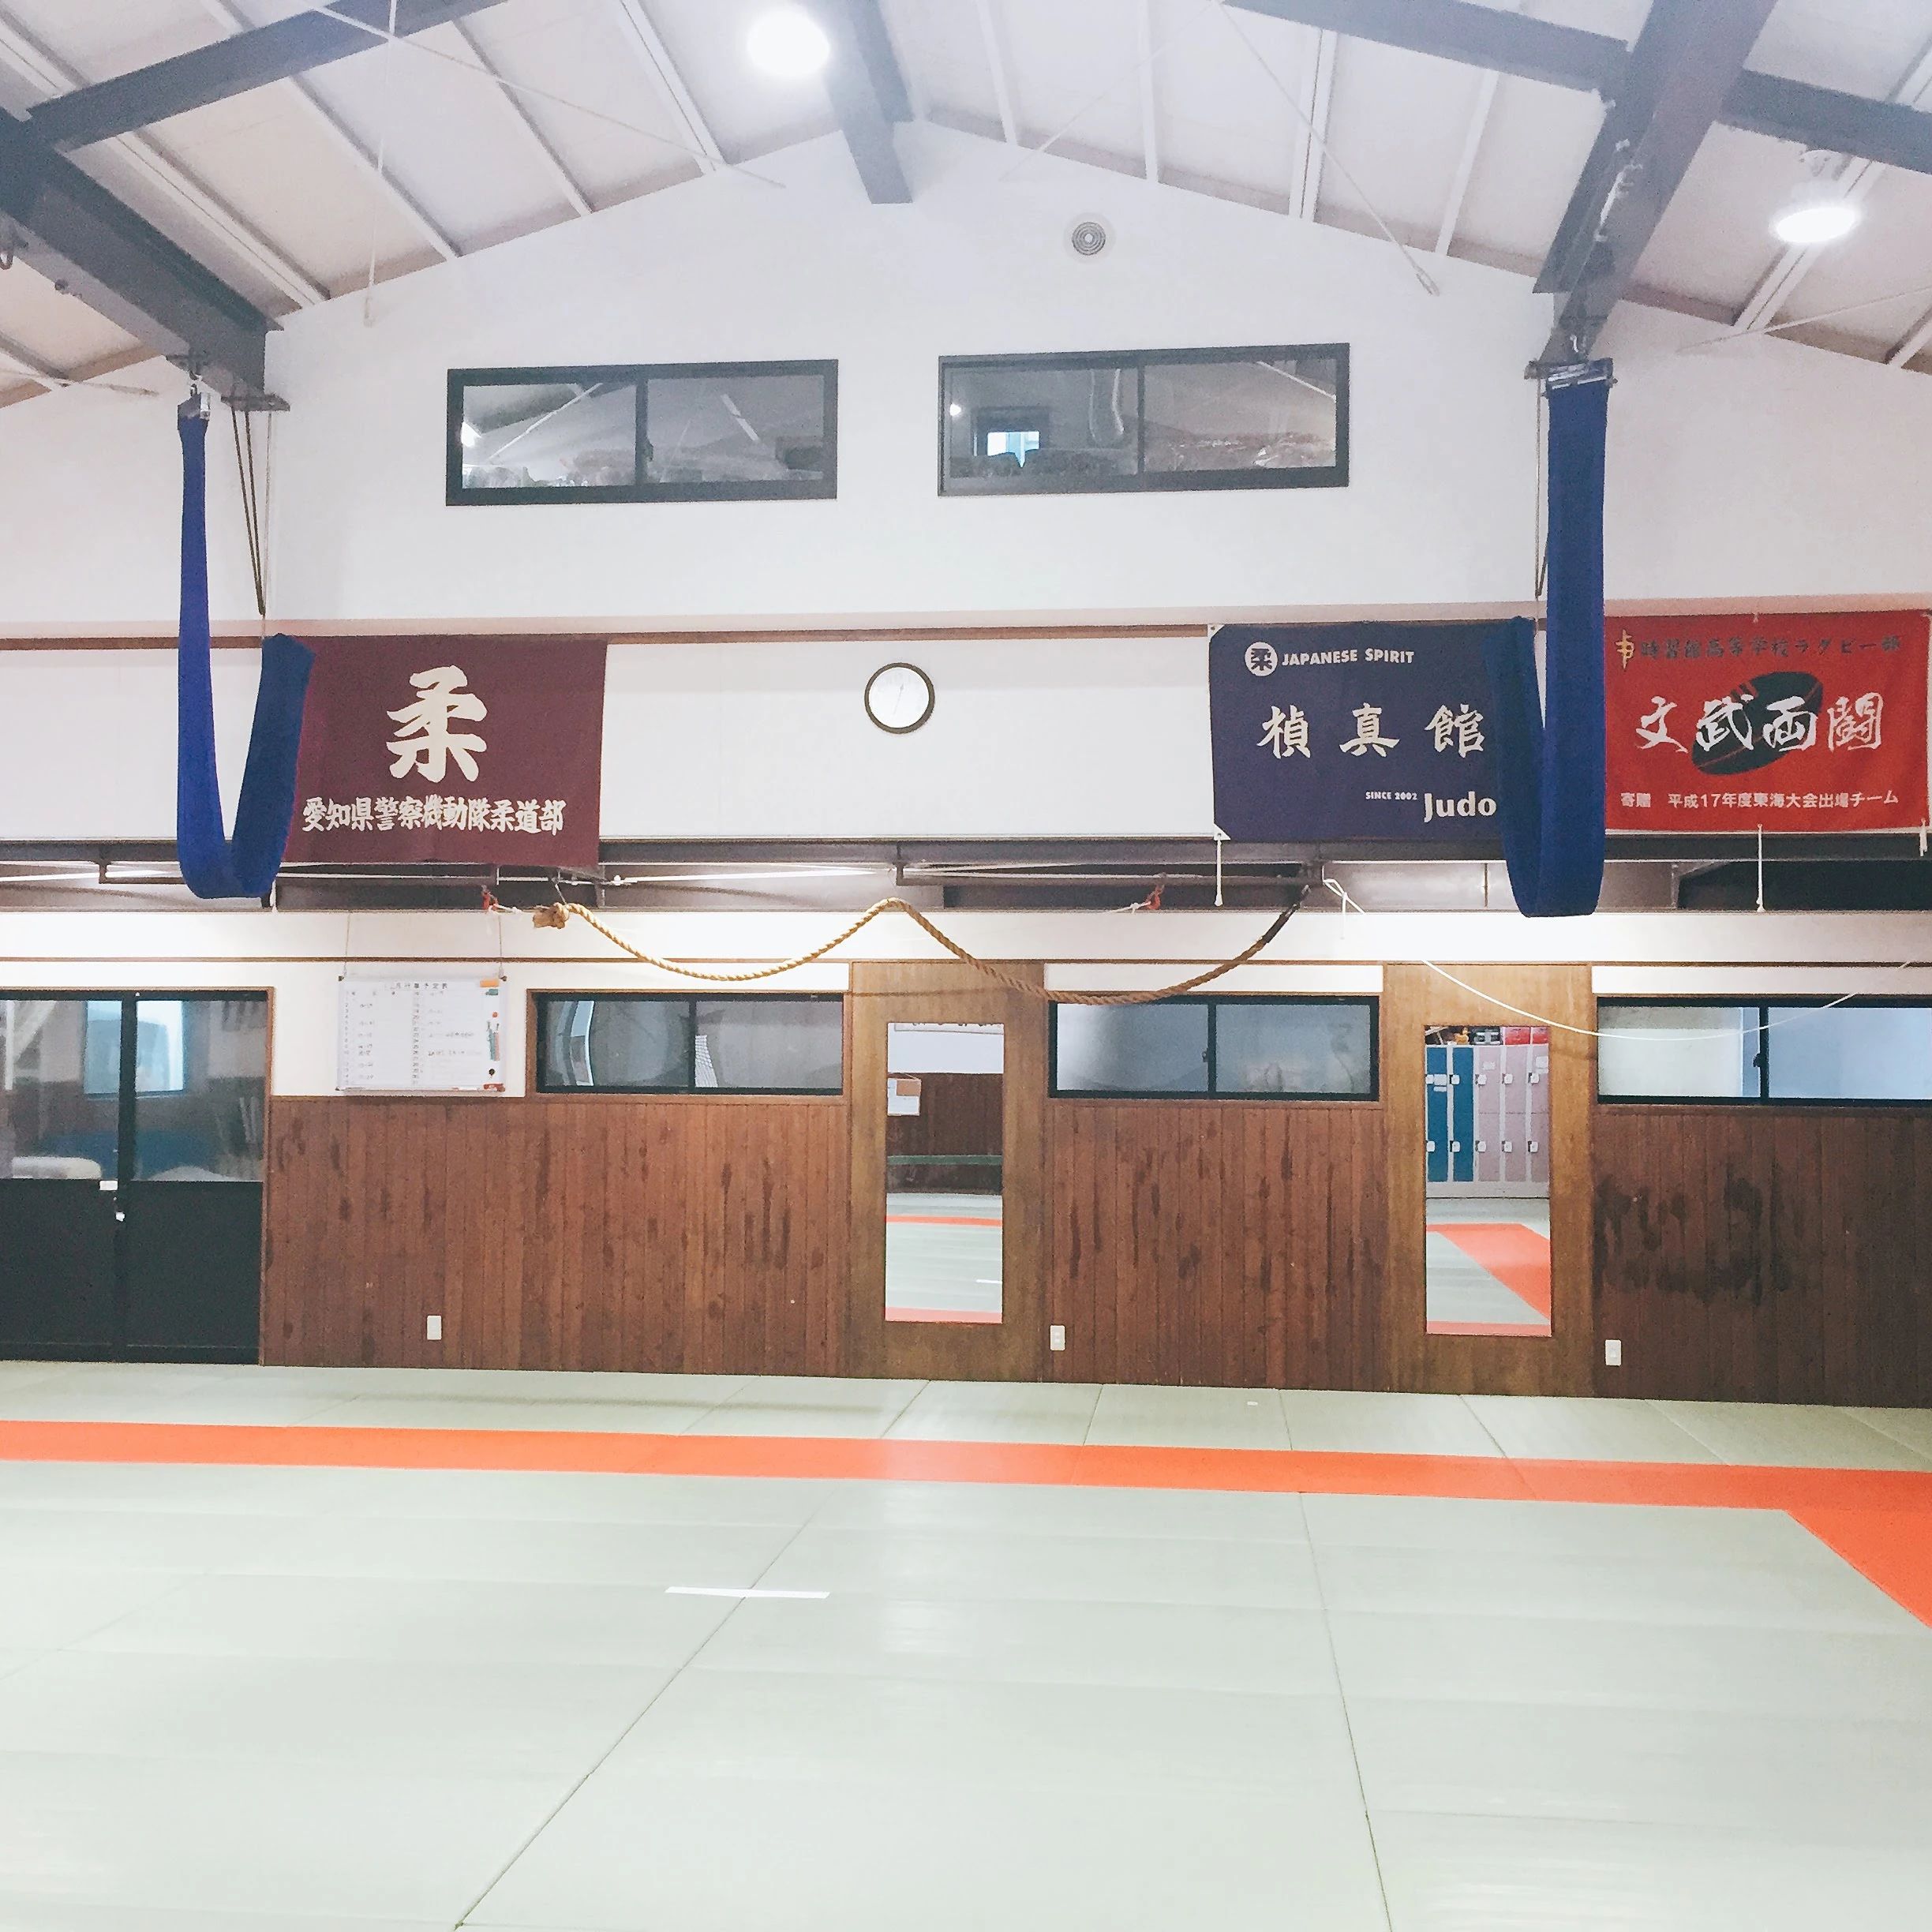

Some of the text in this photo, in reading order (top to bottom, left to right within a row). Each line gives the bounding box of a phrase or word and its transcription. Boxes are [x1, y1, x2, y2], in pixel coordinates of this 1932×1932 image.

[1249, 646, 1274, 672] 柔
[1282, 648, 1414, 666] JAPANESE SPIRIT
[386, 665, 488, 783] 柔
[1365, 791, 1417, 800] SINCE 2002
[1424, 790, 1497, 823] Judo
[1668, 790, 1899, 808] 平成17年度東海大会出場チーム
[301, 793, 567, 836] 愛知県警察機動隊柔道部
